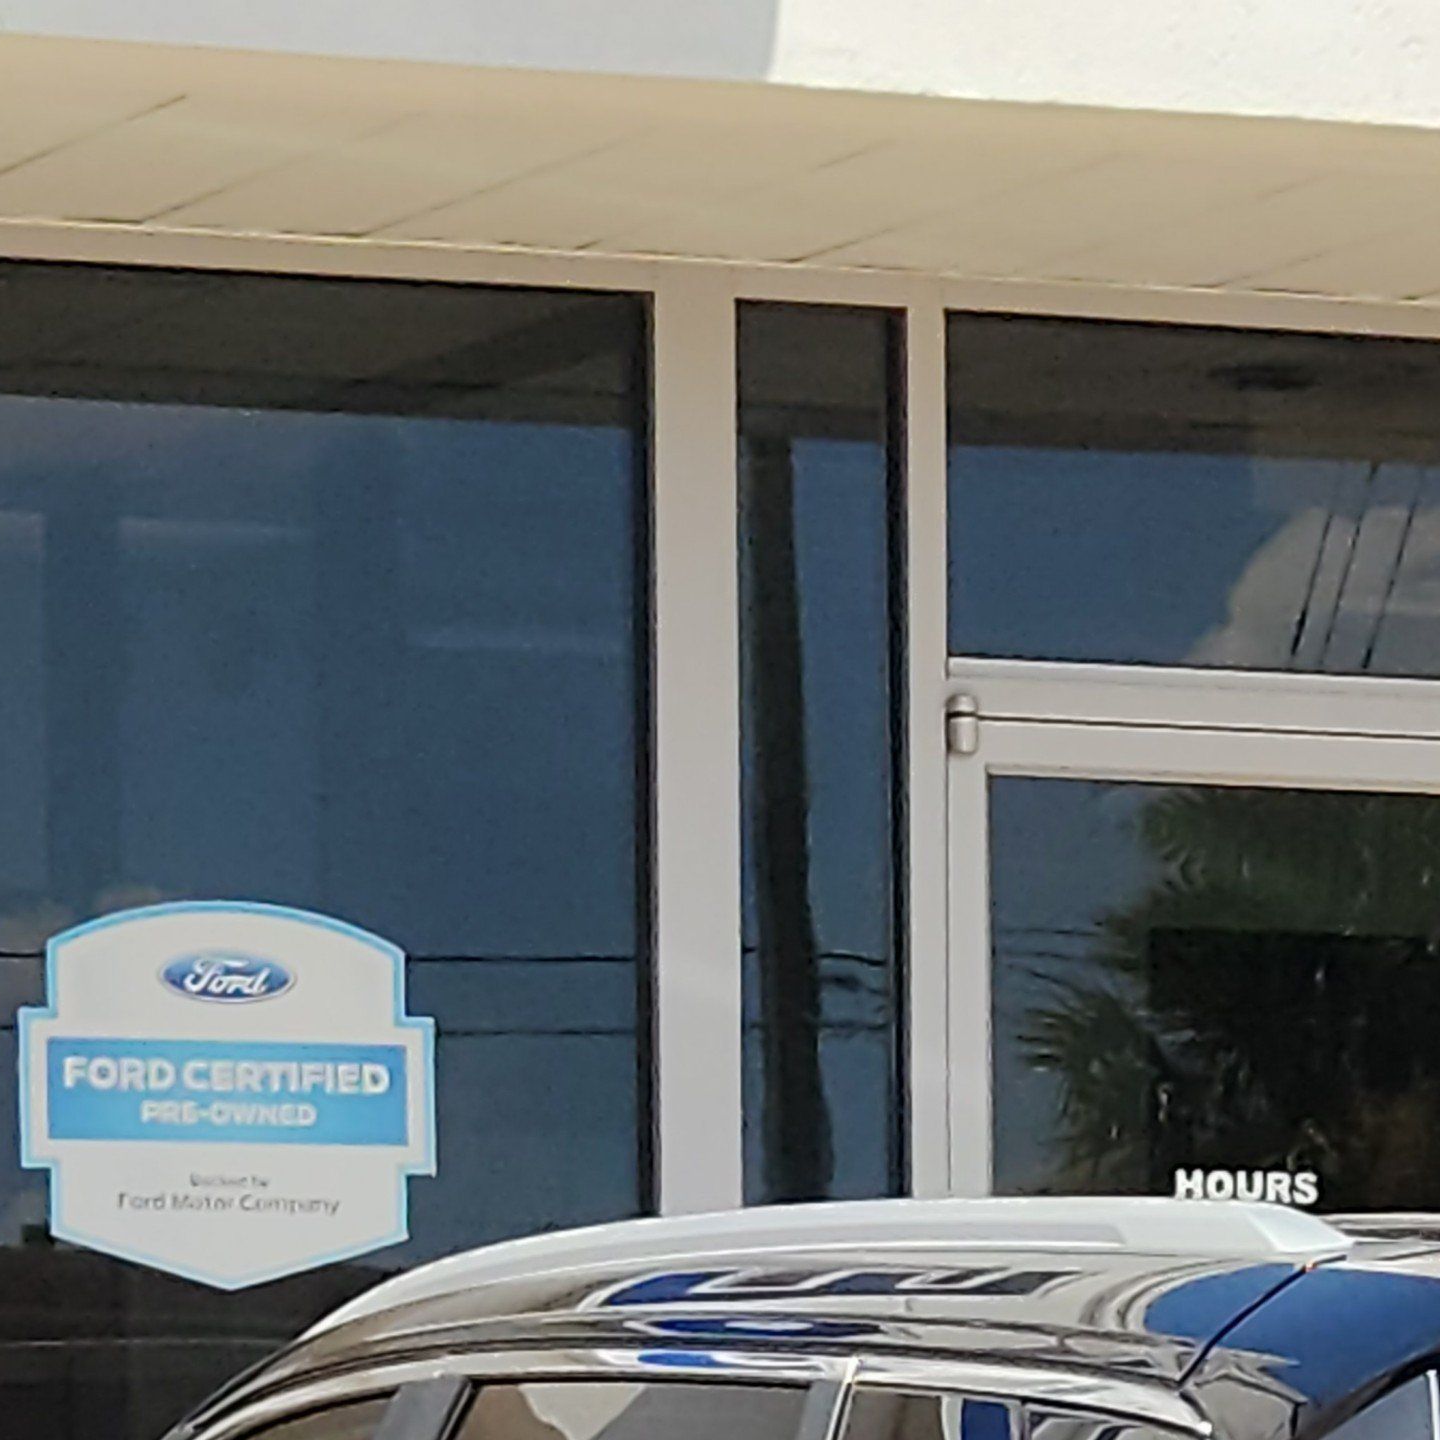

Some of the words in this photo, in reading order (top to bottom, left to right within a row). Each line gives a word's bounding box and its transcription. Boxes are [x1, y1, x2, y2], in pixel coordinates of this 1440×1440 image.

[183, 957, 271, 994] Ford
[62, 1056, 176, 1091] FORD
[182, 1060, 391, 1095] CERTIFIED
[140, 1100, 318, 1127] PRE-OWNED
[117, 1192, 166, 1211] Ford
[239, 1193, 340, 1216] Company
[1174, 1168, 1319, 1205] HOURS
